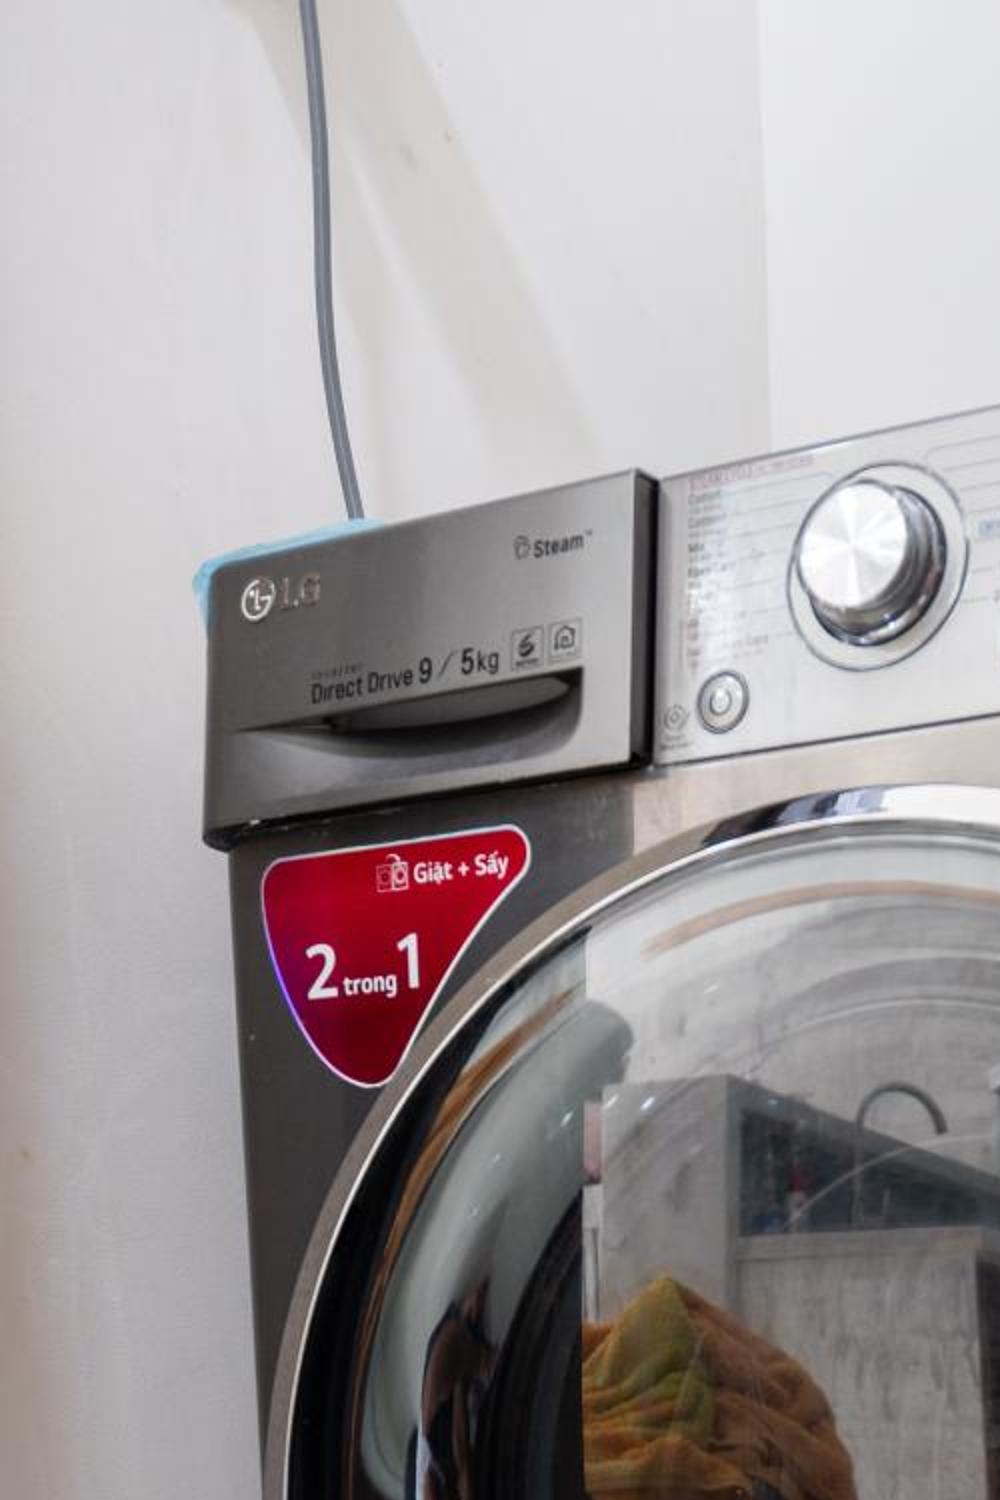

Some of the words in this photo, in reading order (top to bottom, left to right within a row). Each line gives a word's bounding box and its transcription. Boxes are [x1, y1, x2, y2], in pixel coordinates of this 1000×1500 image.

[311, 677, 363, 704] Direct
[368, 667, 413, 693] Drive
[419, 656, 433, 684] 9
[413, 862, 453, 885] Giặt
[457, 863, 470, 878] +
[474, 852, 509, 879] Sấy
[305, 942, 339, 1001] 2
[343, 974, 398, 998] trong
[396, 932, 420, 989] 1
